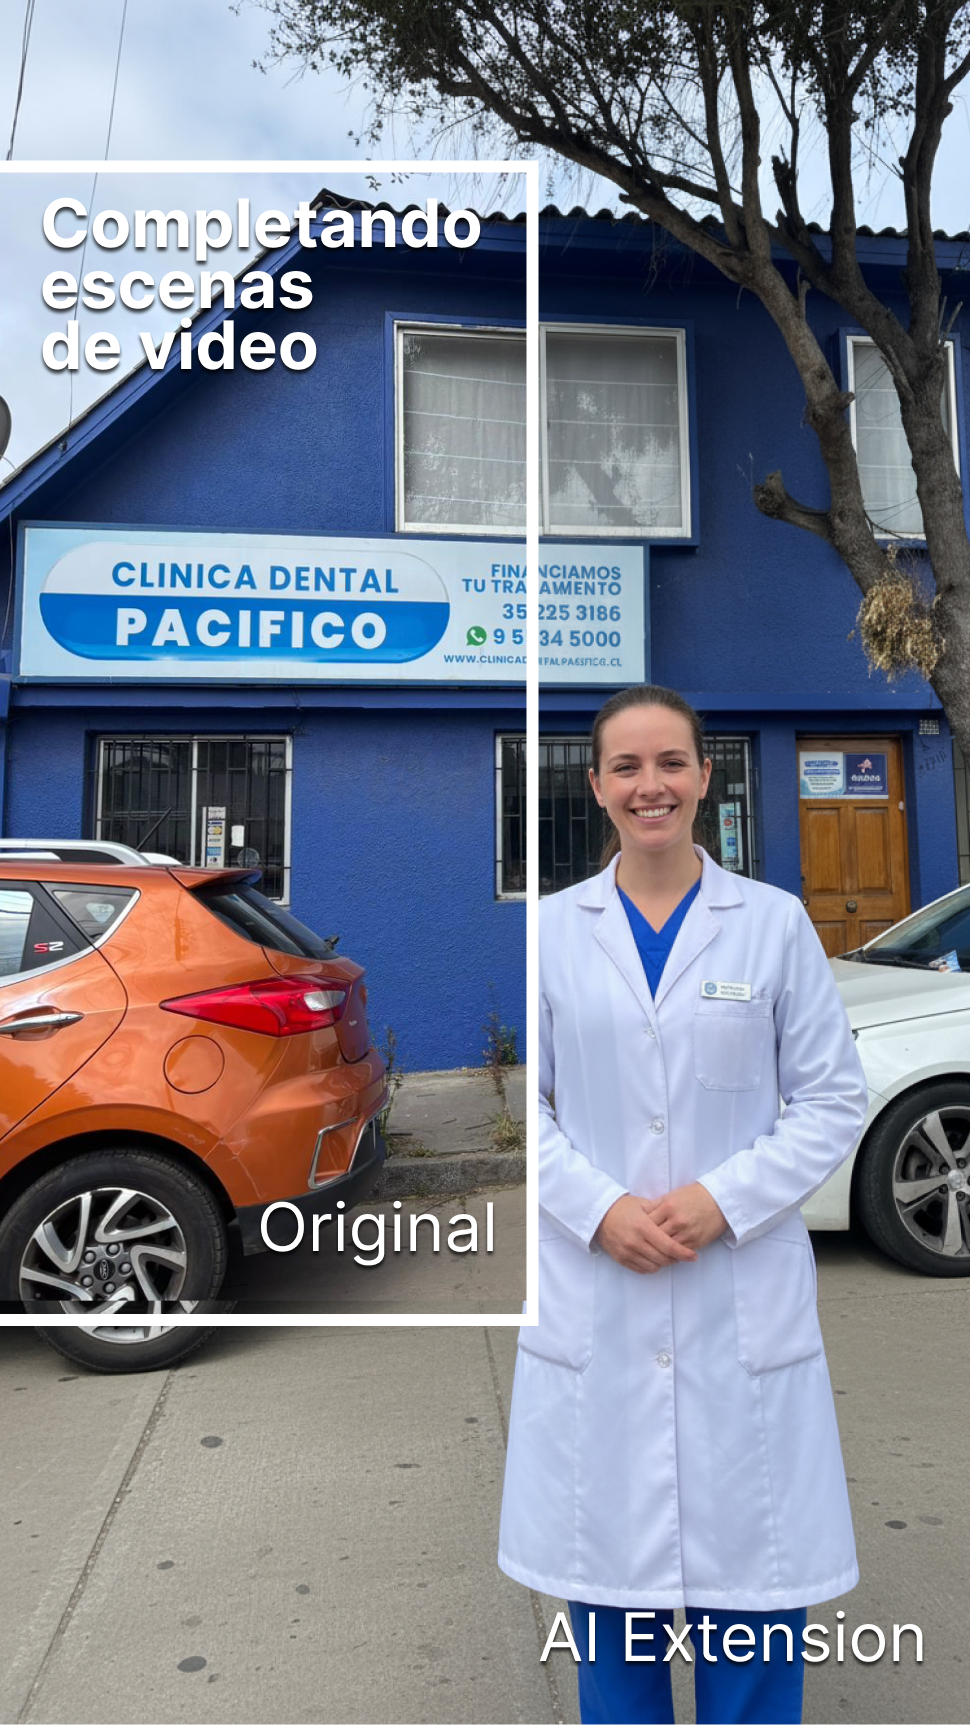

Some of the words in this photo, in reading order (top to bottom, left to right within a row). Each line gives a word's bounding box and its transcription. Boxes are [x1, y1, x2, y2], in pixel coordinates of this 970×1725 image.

[112, 562, 257, 589] CLINICA
[269, 565, 399, 593] DENTAL
[462, 579, 486, 593] TU
[576, 605, 621, 622] 3186
[116, 608, 387, 650] PACIFICO
[493, 628, 505, 645] 9
[570, 630, 621, 647] 5000
[34, 941, 64, 953] S2
